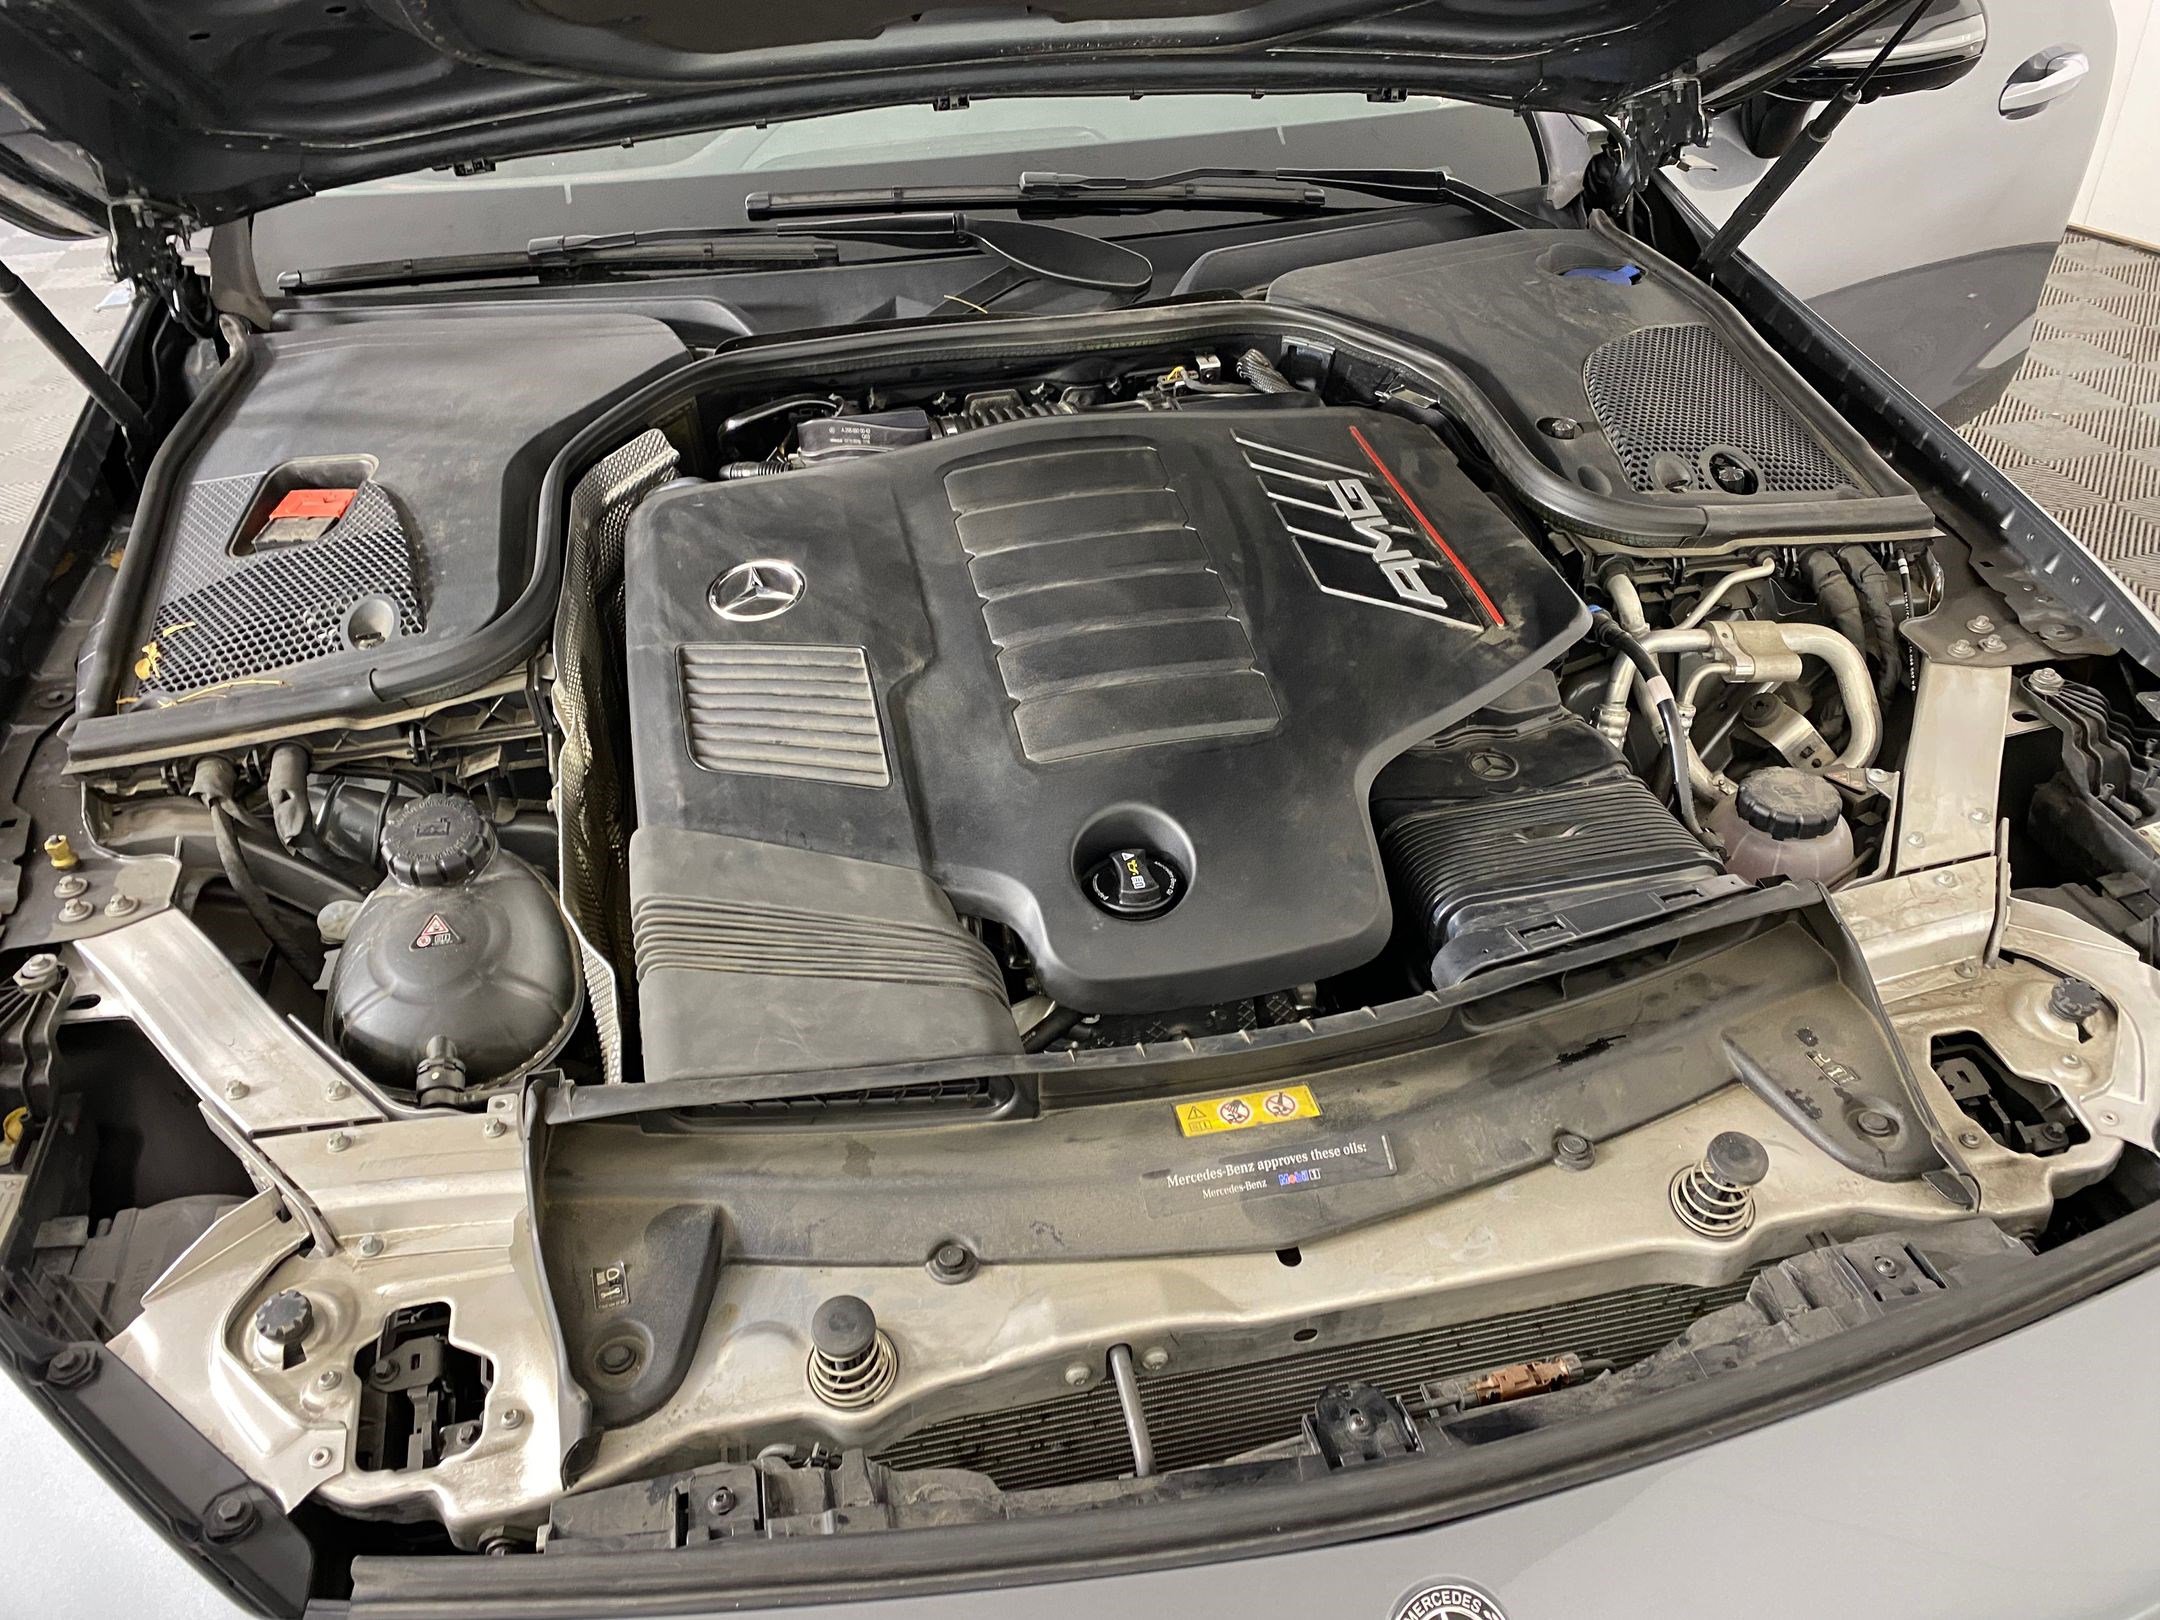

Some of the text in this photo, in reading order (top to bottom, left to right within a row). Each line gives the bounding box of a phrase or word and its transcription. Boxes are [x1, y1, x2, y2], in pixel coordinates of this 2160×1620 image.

[1325, 479, 1447, 609] AMG
[1166, 1162, 1255, 1188] Mercedes-Benz
[1257, 1153, 1308, 1172] approves
[1310, 1148, 1341, 1160] these
[1202, 1180, 1267, 1199] Mercedes-Benz
[1278, 1170, 1309, 1185] Mobil
